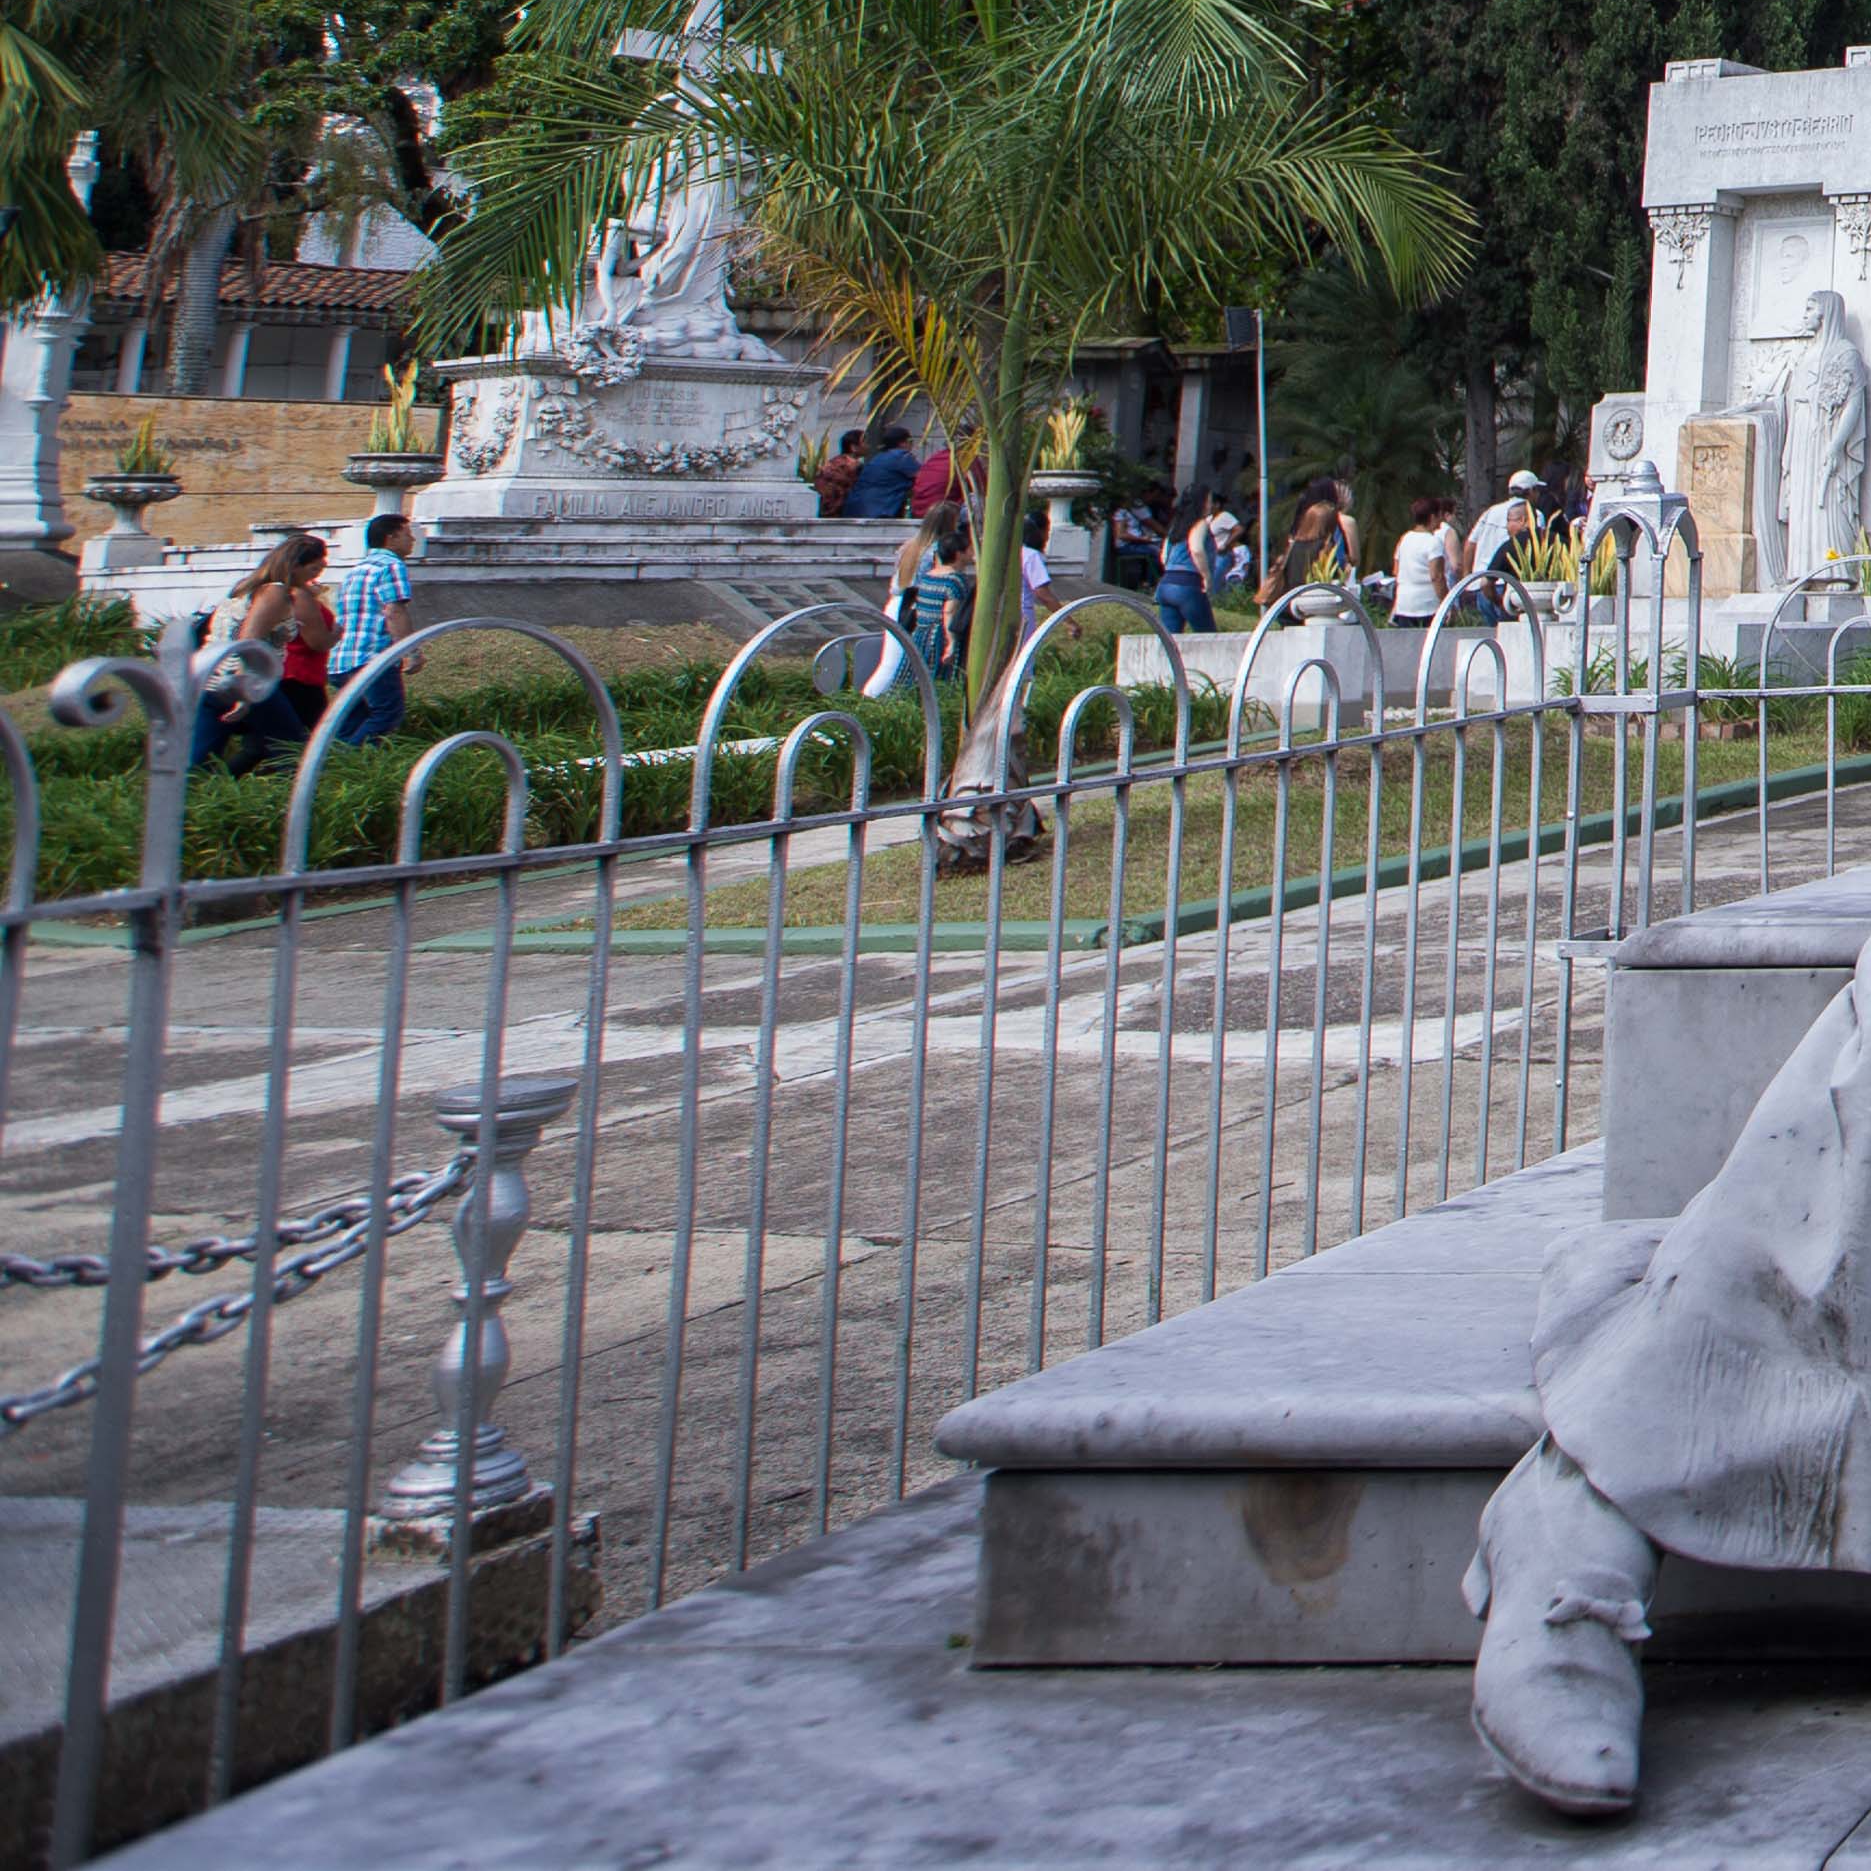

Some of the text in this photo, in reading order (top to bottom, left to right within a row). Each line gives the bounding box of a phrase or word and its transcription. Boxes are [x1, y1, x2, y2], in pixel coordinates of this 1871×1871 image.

[531, 493, 793, 519] FAMILIA ALEJANDRO ANGEL
